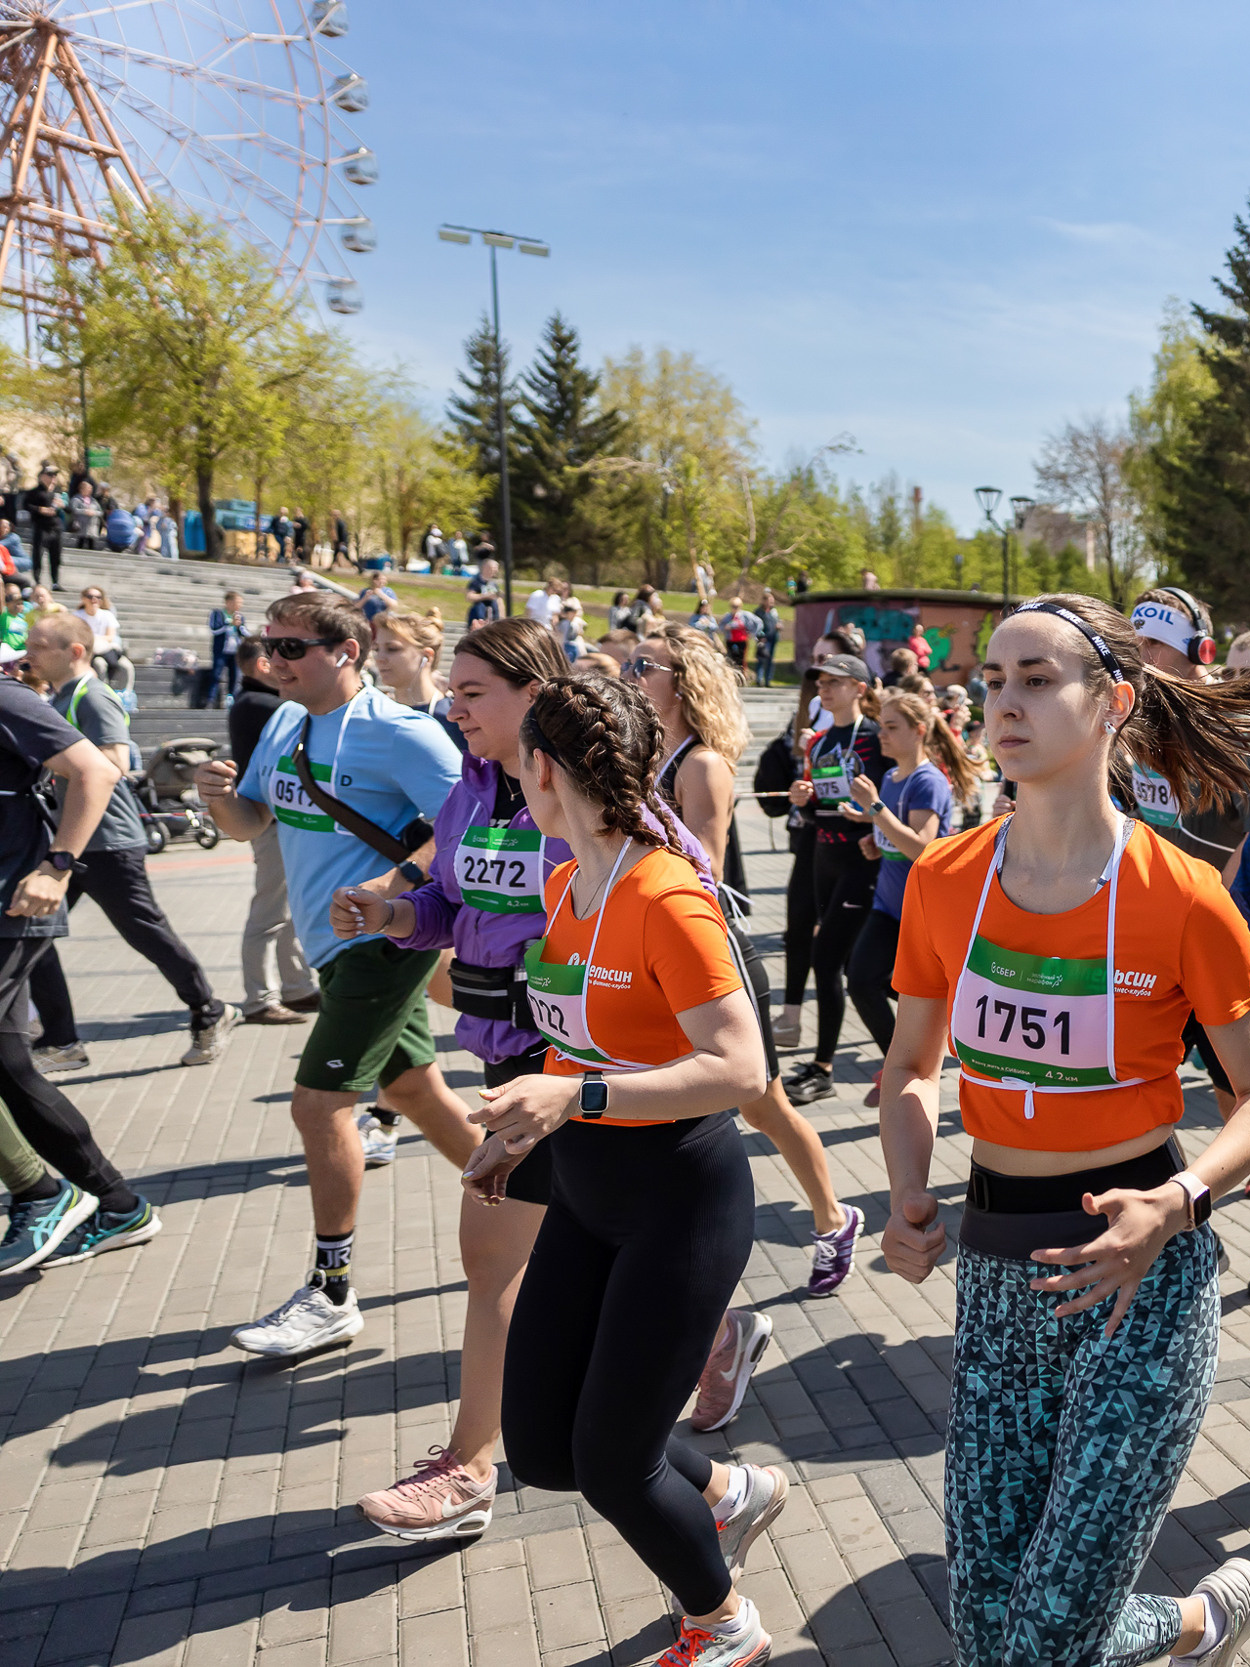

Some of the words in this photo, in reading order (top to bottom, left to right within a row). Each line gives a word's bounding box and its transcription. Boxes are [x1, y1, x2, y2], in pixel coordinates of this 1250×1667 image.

[1056, 608, 1084, 625] NIKE
[1092, 636, 1110, 656] NIKE
[275, 780, 314, 807] 051
[463, 856, 526, 888] 2272
[996, 966, 1016, 977] СБЕР
[975, 995, 1070, 1055] 1751
